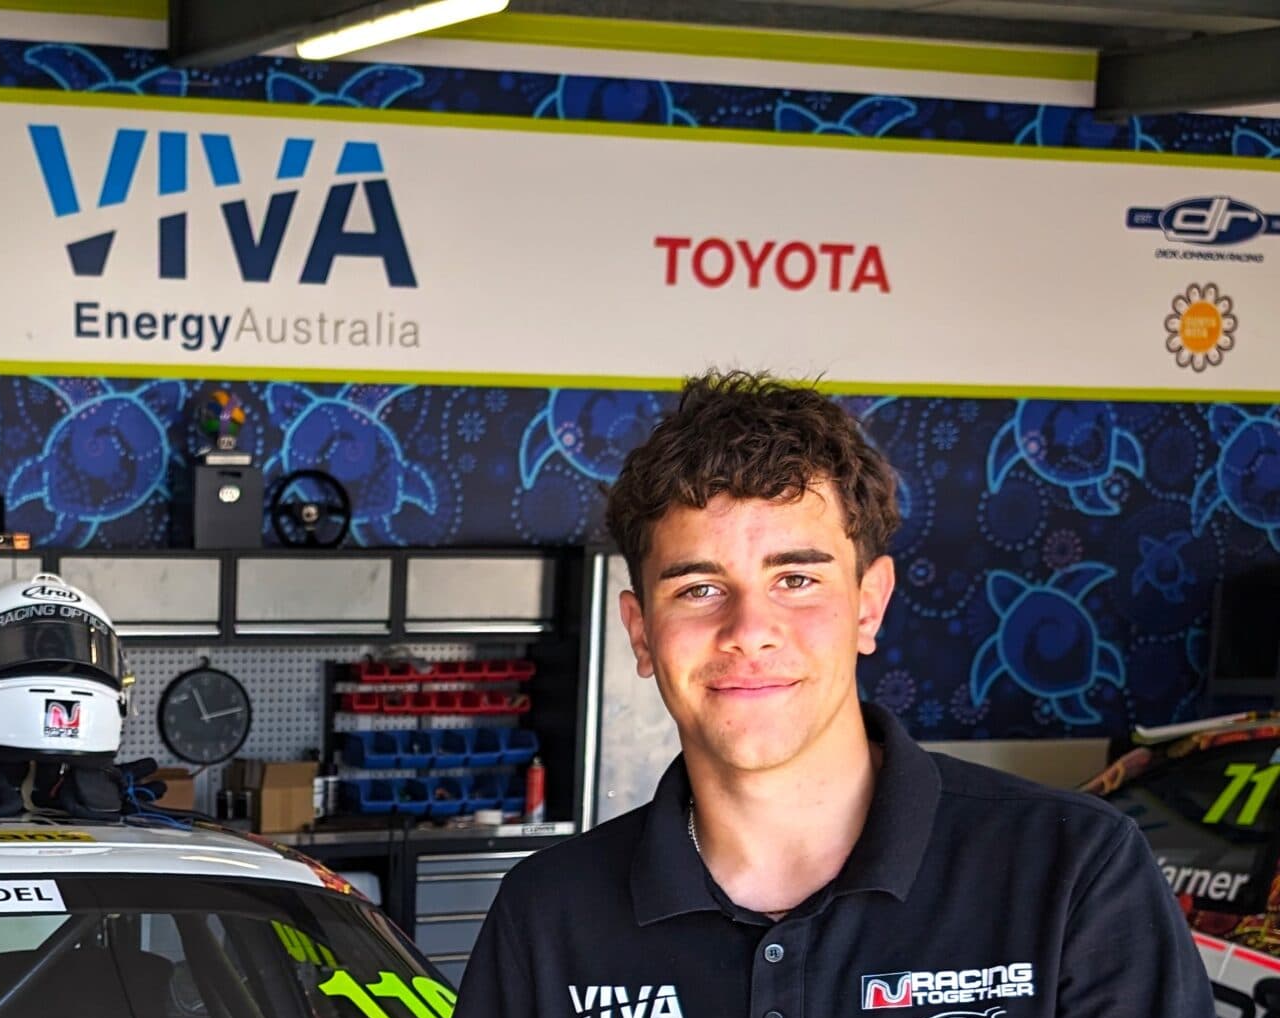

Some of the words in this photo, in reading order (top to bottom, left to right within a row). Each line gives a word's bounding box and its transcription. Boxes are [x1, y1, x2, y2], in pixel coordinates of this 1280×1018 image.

[27, 124, 418, 288] VIVA
[655, 236, 891, 294] TOYOTA
[74, 302, 421, 352] EnergyAustralia
[1157, 857, 1249, 901] arner
[912, 962, 1032, 991] RACING
[913, 983, 1034, 1006] TOGETHER
